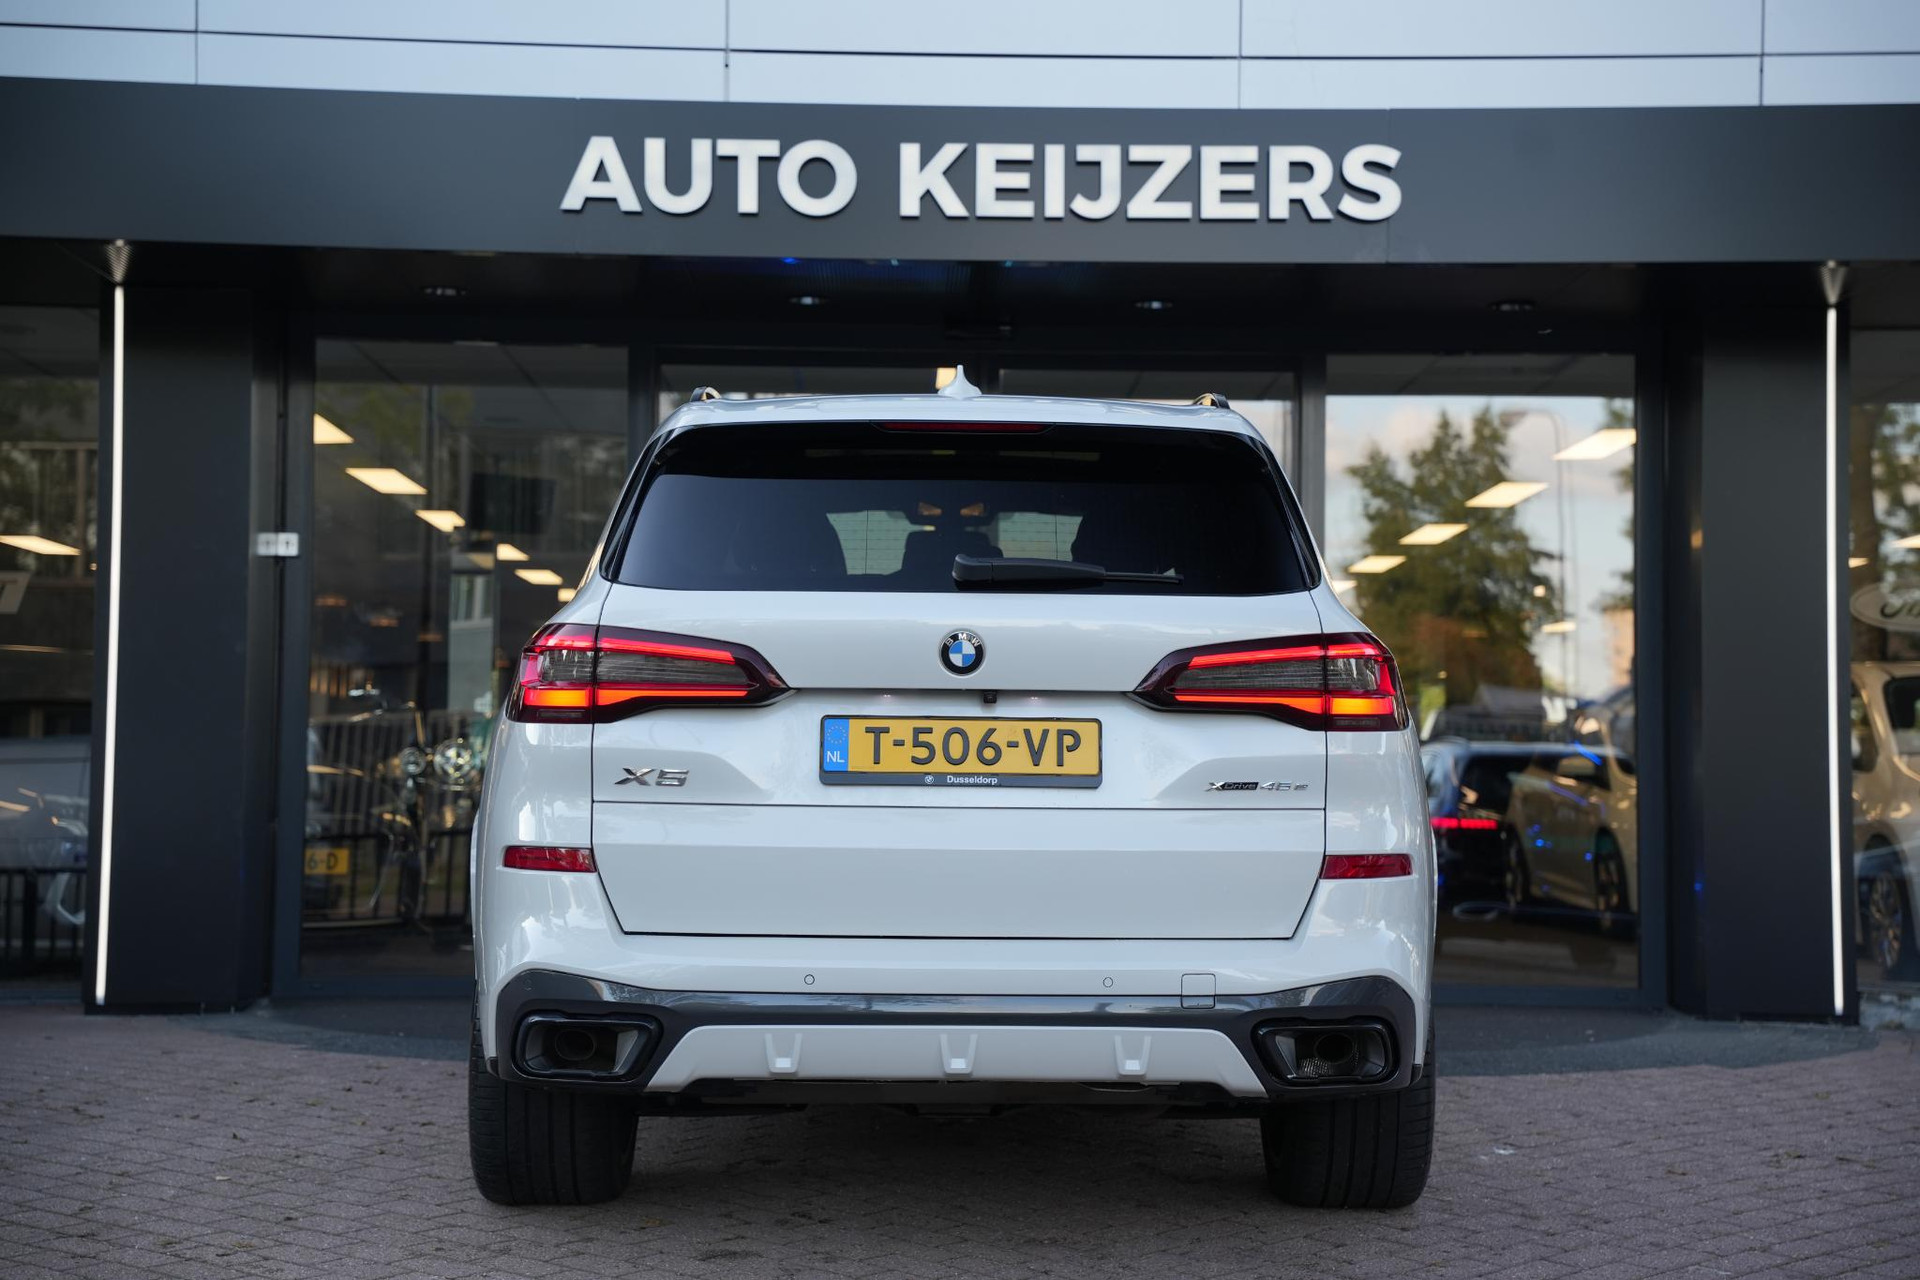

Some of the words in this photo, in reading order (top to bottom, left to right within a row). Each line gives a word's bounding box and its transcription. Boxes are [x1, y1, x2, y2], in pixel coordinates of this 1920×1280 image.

[559, 135, 858, 217] AUTO
[899, 142, 1402, 222] KEIJZERS
[826, 750, 845, 763] NL
[865, 726, 1082, 767] T-506-VP
[614, 767, 690, 787] X5
[946, 775, 998, 785] Dusseldorp
